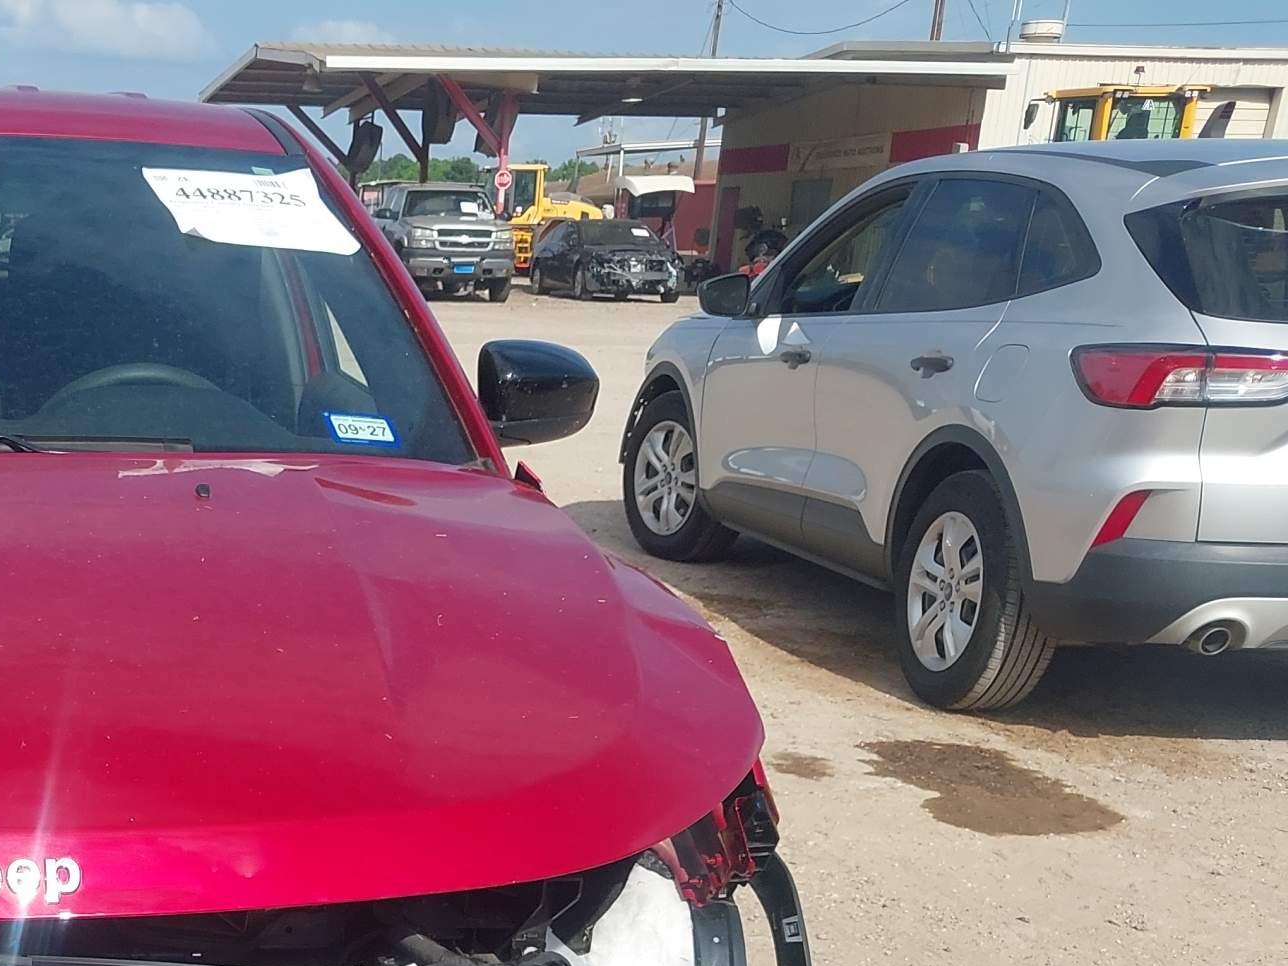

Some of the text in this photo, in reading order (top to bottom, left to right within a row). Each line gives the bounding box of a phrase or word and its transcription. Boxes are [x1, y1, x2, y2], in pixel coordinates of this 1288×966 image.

[175, 187, 306, 207] 44887325
[337, 423, 386, 437] 09 27
